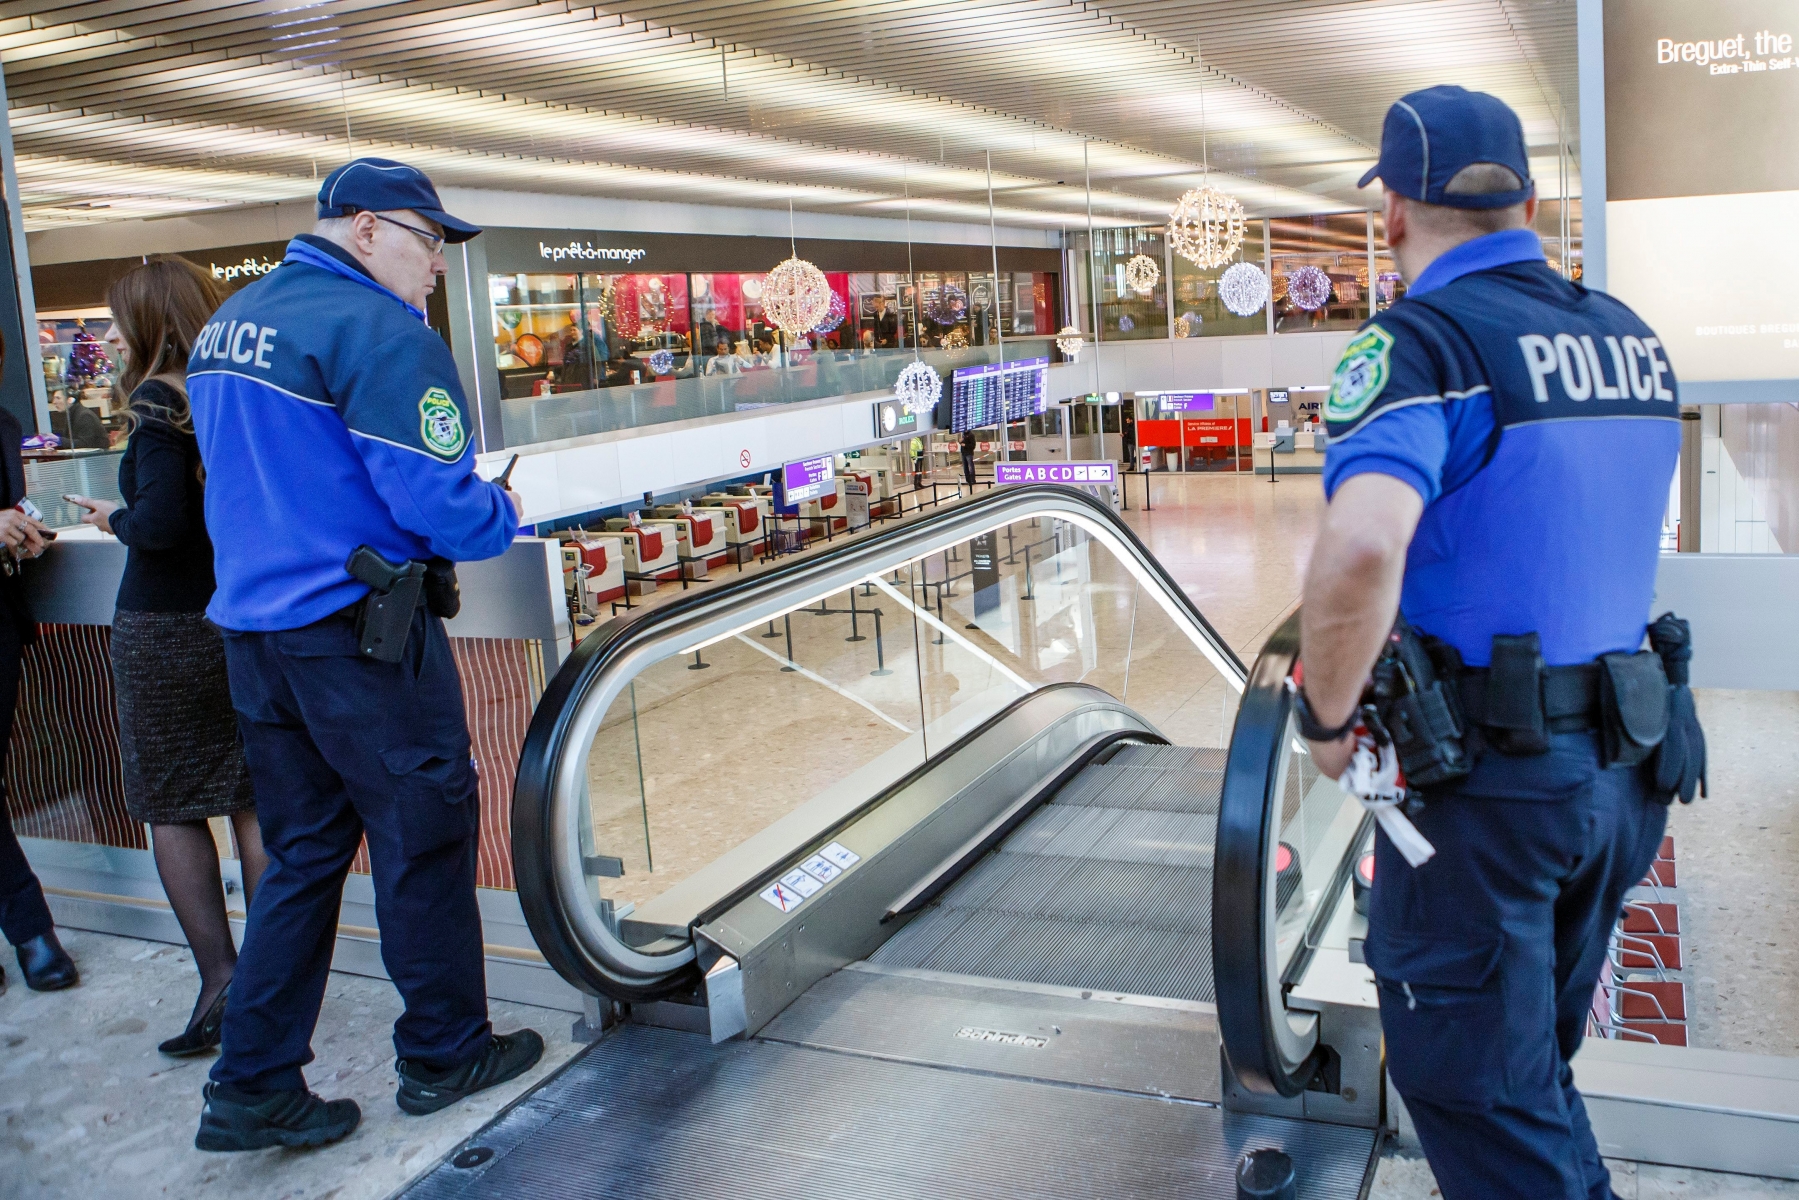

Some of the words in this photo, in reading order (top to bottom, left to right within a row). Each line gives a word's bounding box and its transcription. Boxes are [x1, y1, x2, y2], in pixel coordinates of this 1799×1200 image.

[1657, 33, 1751, 66] Breguet,
[1754, 29, 1793, 56] the
[1709, 60, 1767, 75] Extra-Thin
[1695, 324, 1757, 336] BOUTIQUES
[190, 319, 278, 370] POLICE
[1517, 333, 1674, 403] POLICE
[1025, 468, 1034, 480] A
[1038, 468, 1046, 480] B
[1050, 468, 1058, 480] C
[1062, 468, 1072, 480] D
